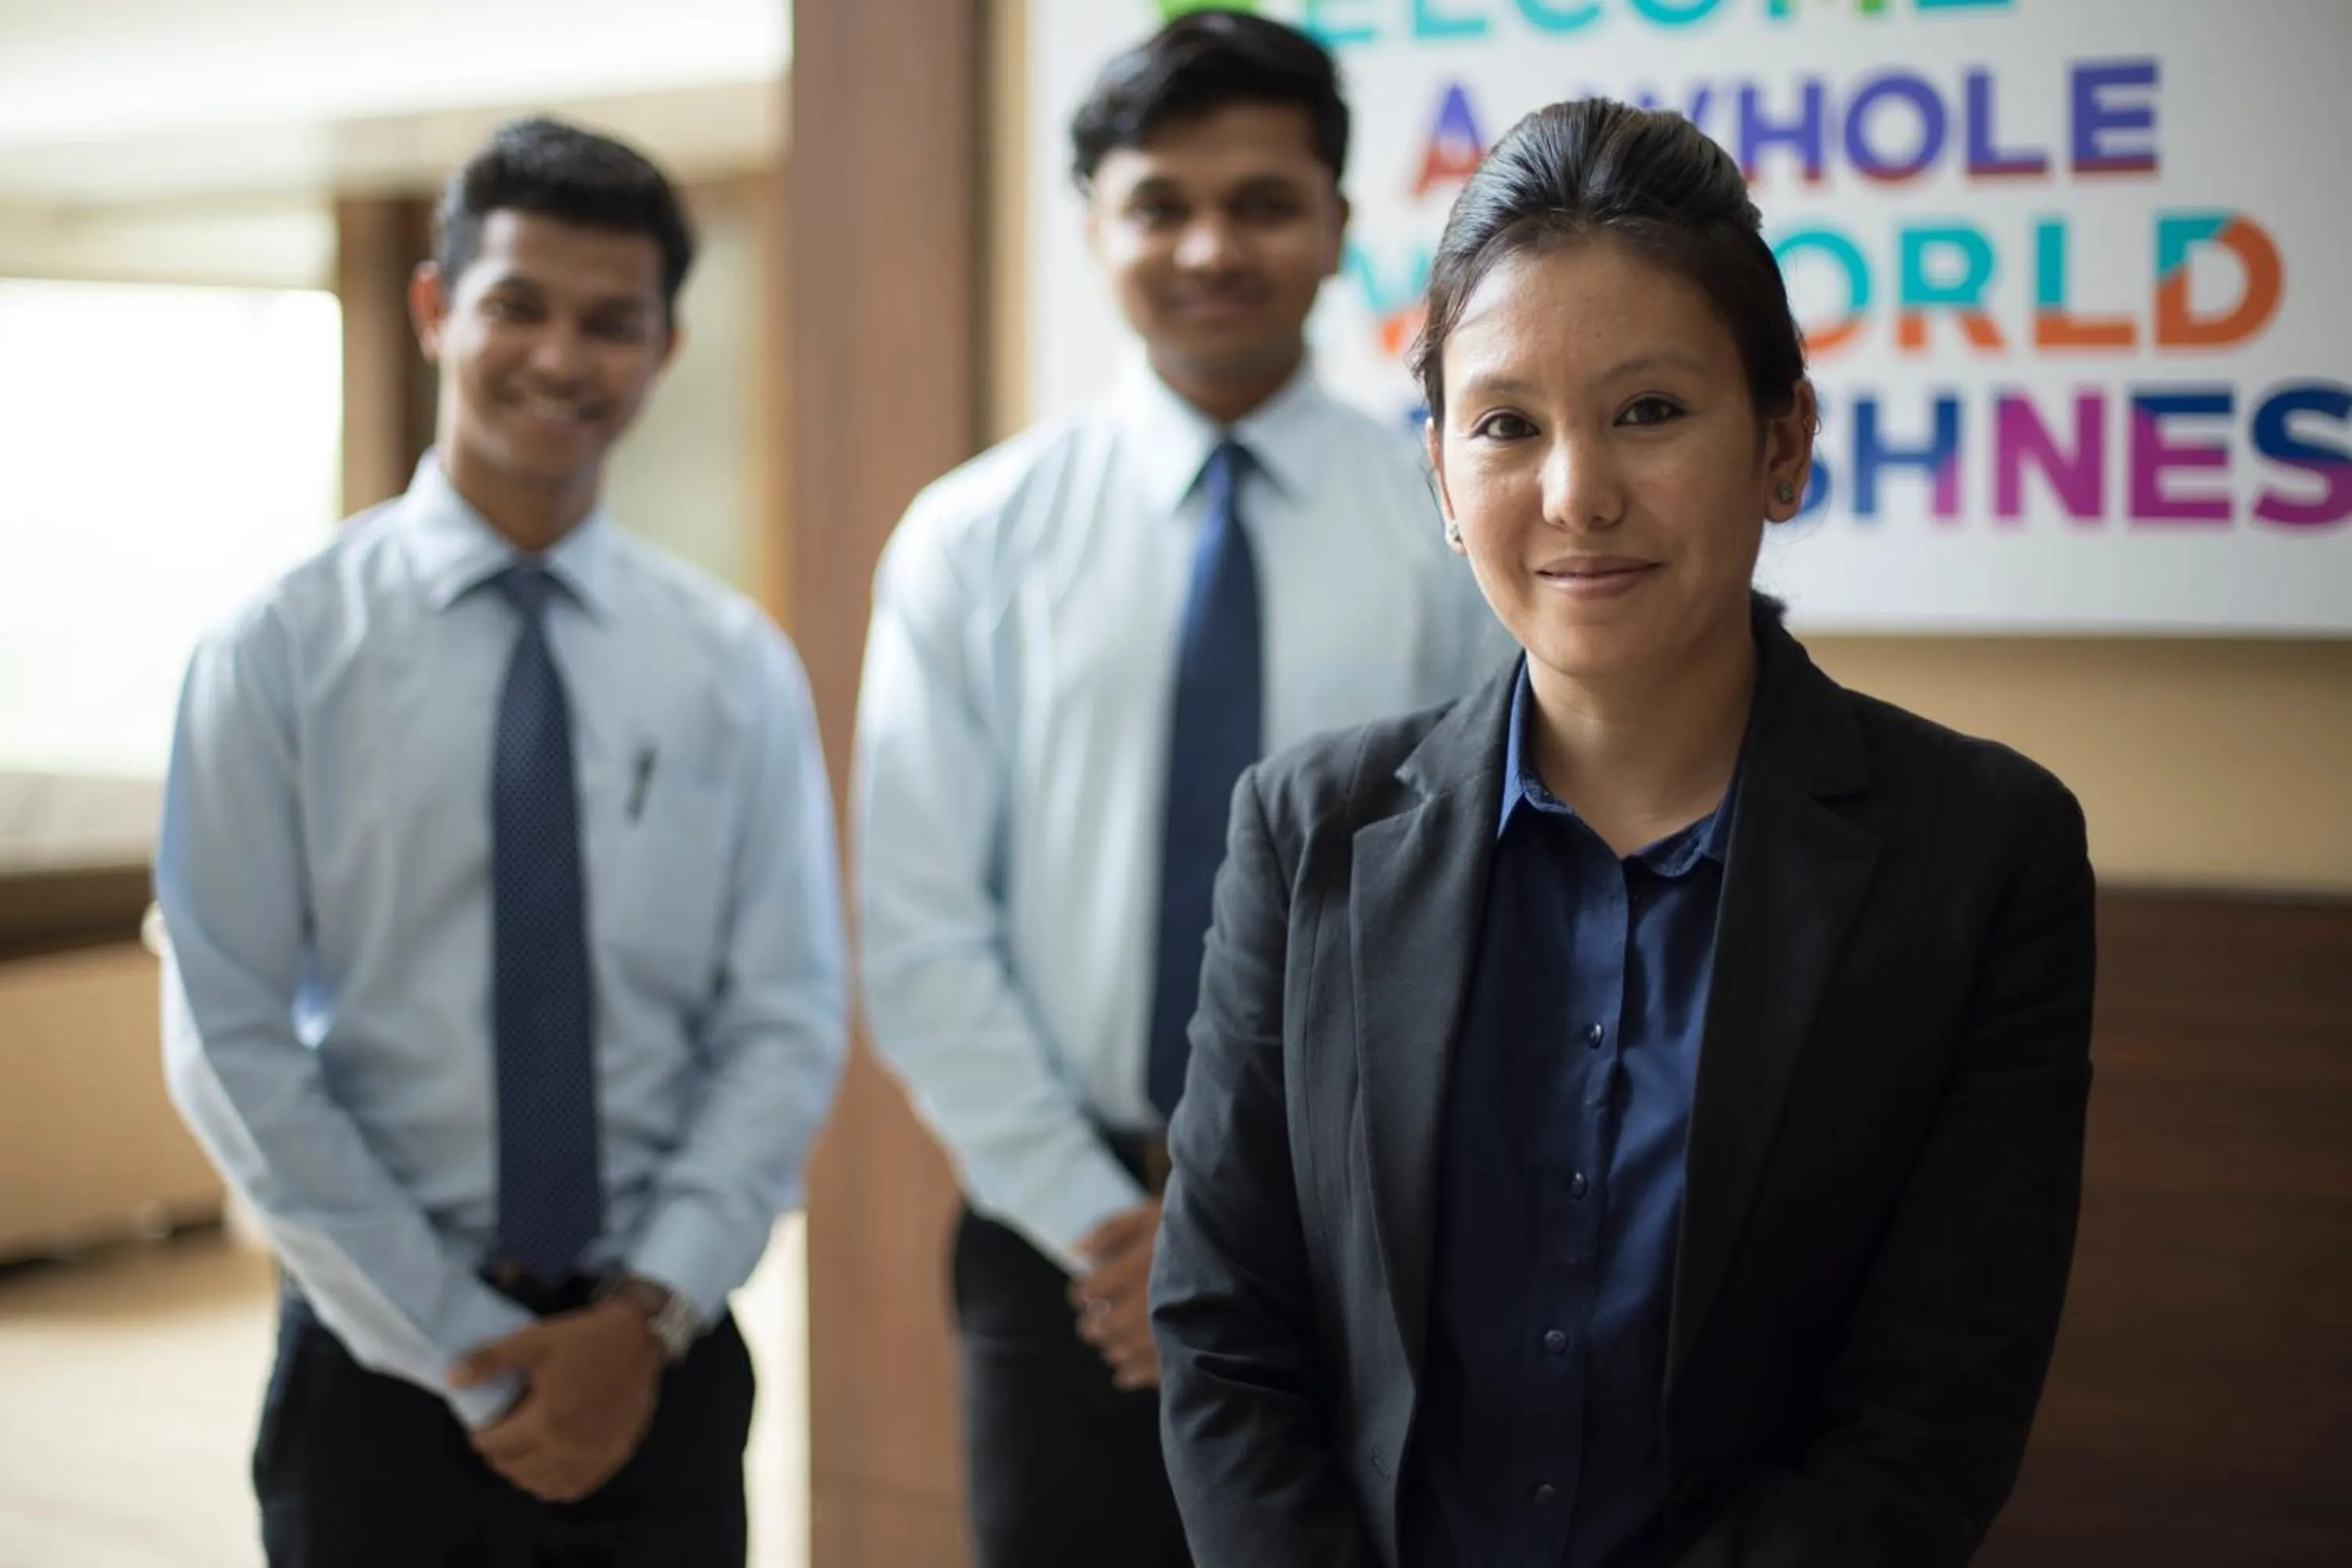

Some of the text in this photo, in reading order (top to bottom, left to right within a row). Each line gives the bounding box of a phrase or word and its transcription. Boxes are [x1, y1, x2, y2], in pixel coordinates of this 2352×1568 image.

[1410, 58, 2159, 201] A HOLE
[1770, 213, 2285, 353] ORLD
[1795, 383, 2352, 529] HNES
